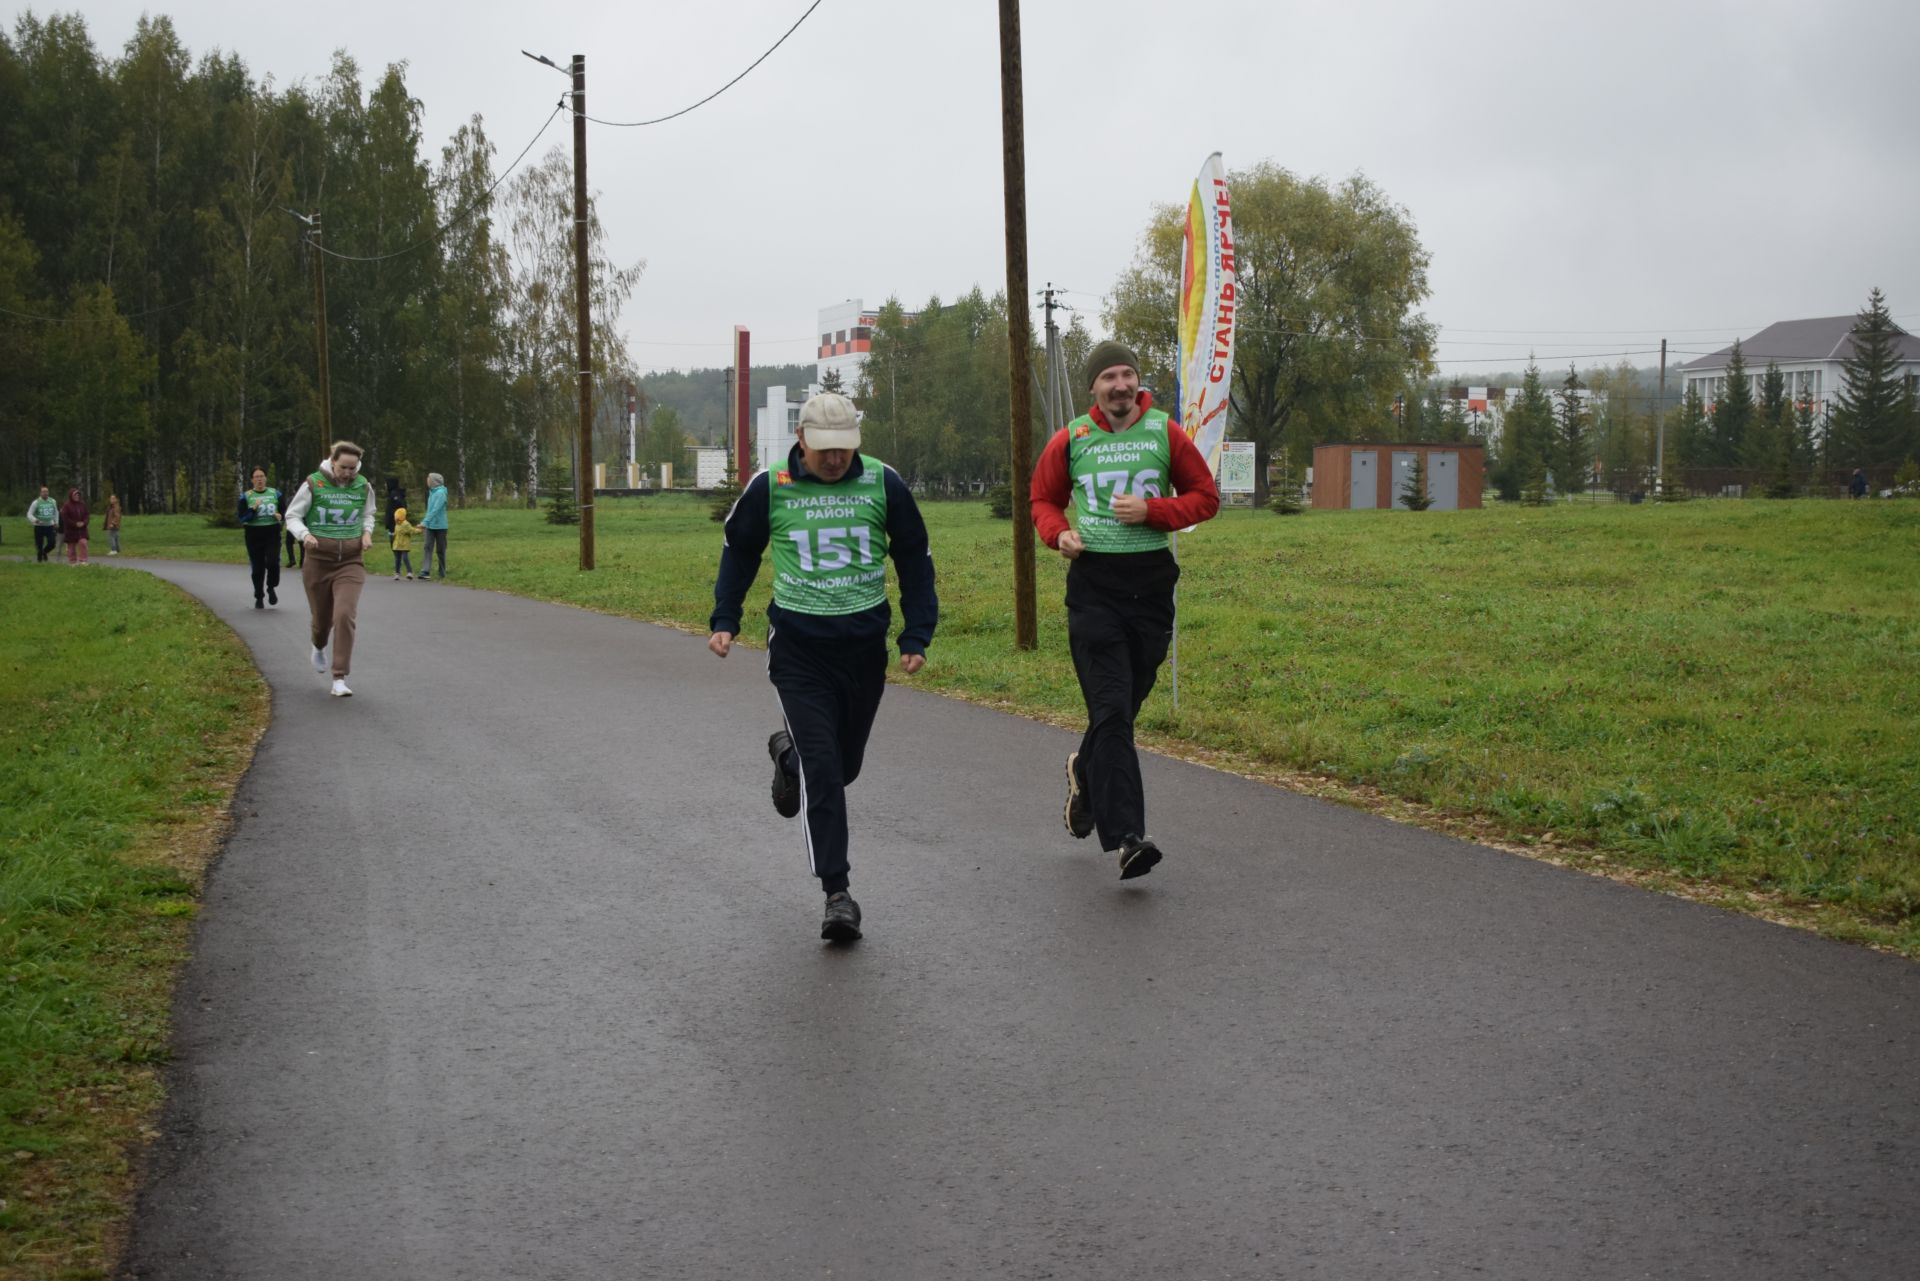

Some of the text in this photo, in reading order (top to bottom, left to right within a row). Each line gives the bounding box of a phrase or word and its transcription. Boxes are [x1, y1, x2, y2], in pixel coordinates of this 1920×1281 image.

[1213, 206, 1221, 291] СПОРТОМ
[1210, 178, 1235, 383] СТАНЬ ЯРЧЕ!
[1097, 453, 1140, 464] РАЙОН
[1078, 469, 1161, 512] 176
[806, 507, 855, 520] РАЙОН
[788, 526, 873, 572] 151
